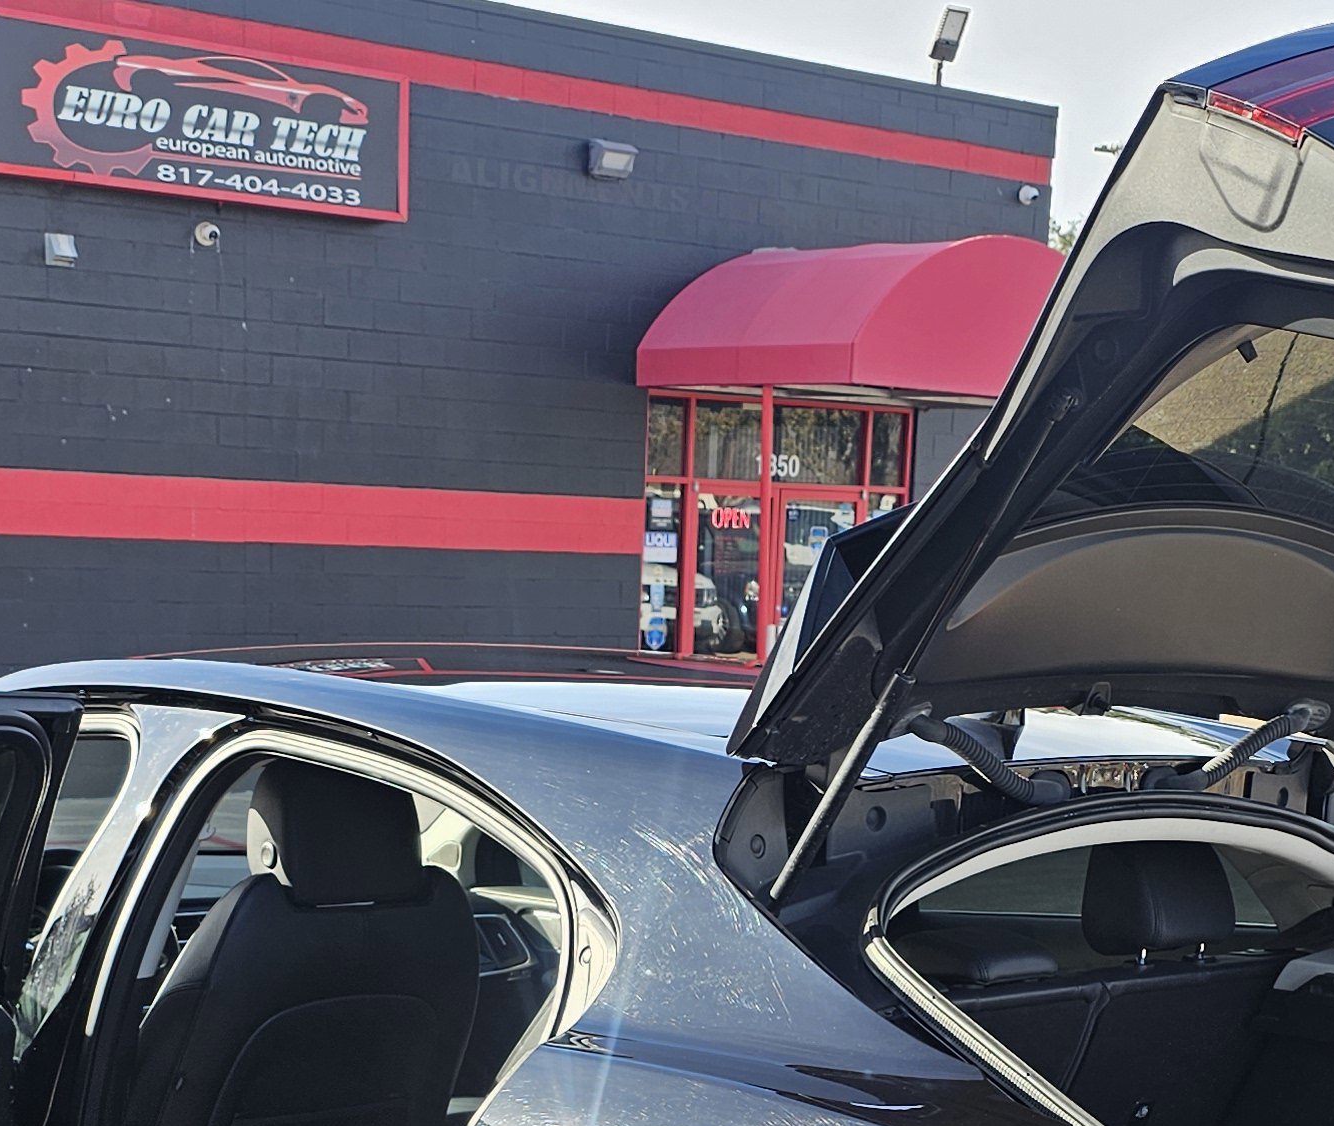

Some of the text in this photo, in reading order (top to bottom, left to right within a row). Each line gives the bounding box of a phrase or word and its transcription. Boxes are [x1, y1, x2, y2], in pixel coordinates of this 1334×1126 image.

[57, 85, 368, 163] EURO CAR TECH
[156, 135, 362, 177] european automotive
[156, 164, 362, 206] 817-404-4033
[711, 507, 750, 529] OPEN
